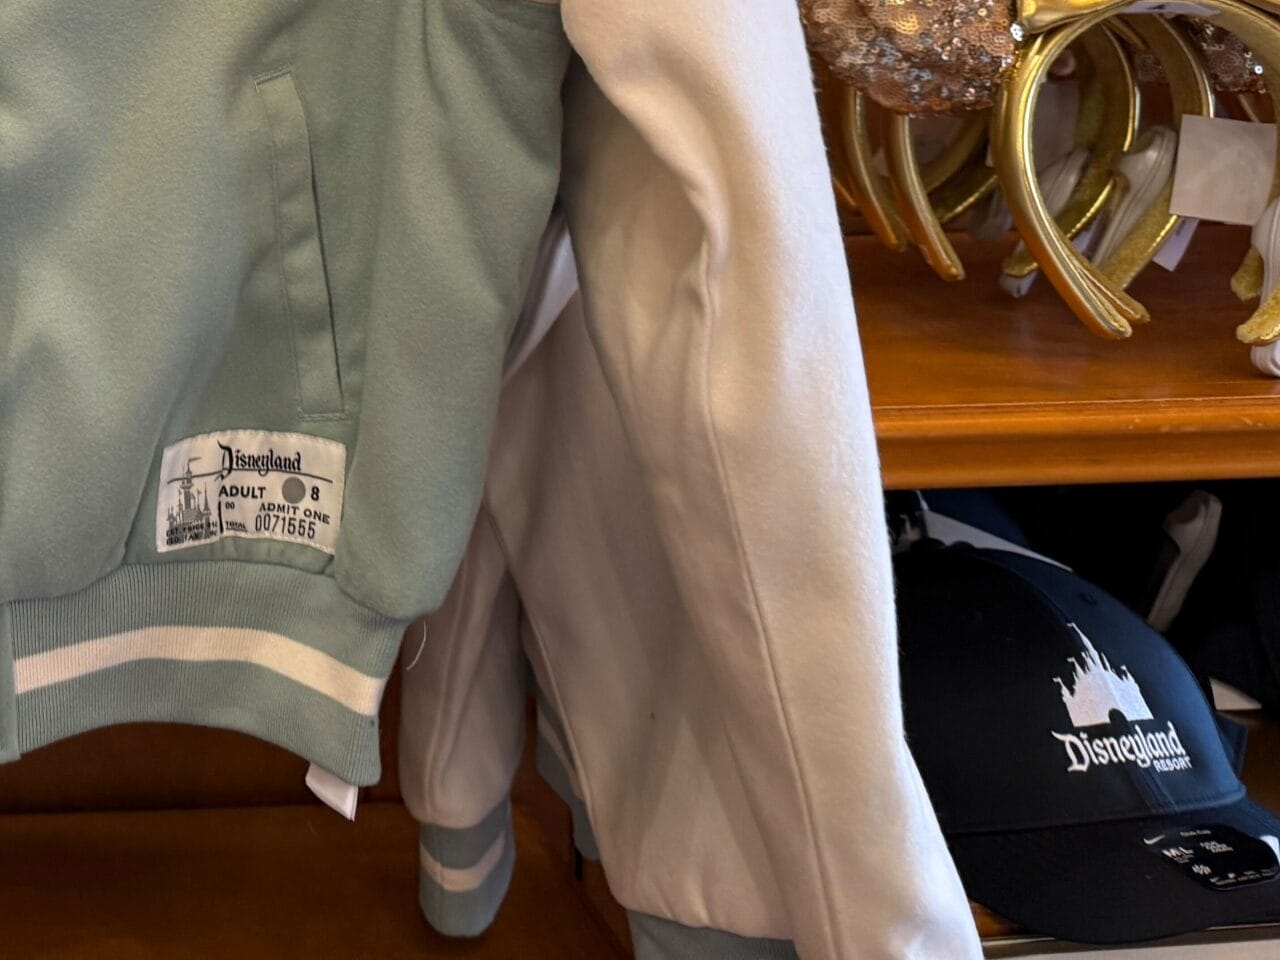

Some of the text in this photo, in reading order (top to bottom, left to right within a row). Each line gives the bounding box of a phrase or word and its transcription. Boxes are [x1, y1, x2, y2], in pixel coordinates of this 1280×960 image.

[215, 440, 302, 481] Disneyland
[219, 485, 320, 501] ADULT 8
[259, 502, 331, 525] ADMIT ONE
[255, 513, 316, 539] 0071555
[1051, 720, 1186, 772] Disneyland
[1153, 756, 1192, 773] RESORT
